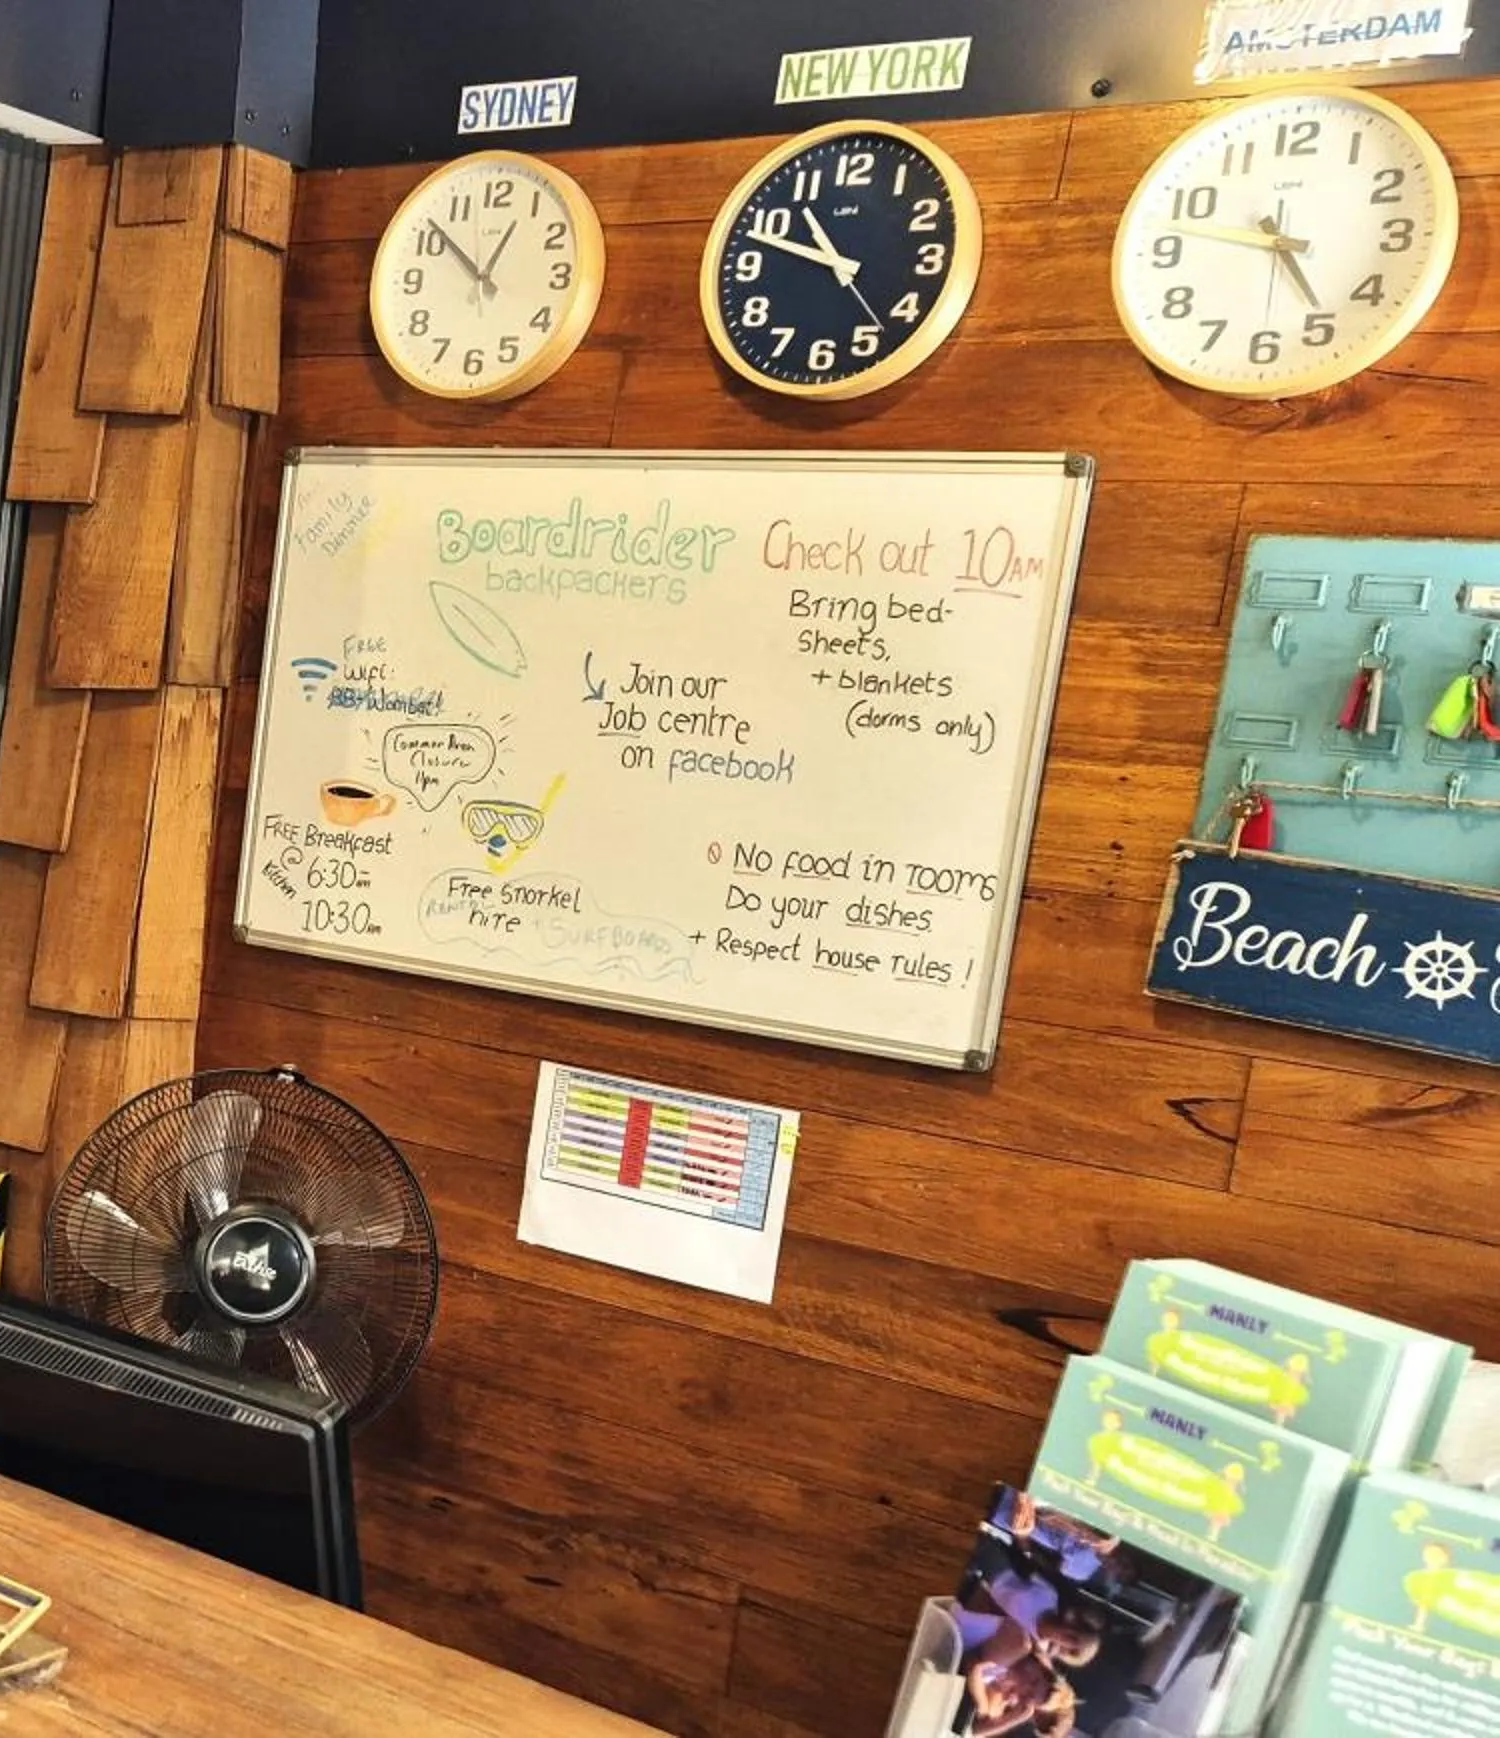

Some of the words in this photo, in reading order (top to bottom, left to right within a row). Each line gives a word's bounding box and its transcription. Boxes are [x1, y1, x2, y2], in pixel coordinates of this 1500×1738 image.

[781, 50, 857, 99] NEW
[867, 41, 967, 92] YORK
[462, 81, 575, 129] SYDNEY
[1274, 121, 1321, 157] 12
[1348, 131, 1362, 165] 1
[835, 153, 874, 186] 12
[1221, 142, 1255, 176] 11
[483, 180, 514, 209] 12
[793, 170, 822, 201] 11
[893, 163, 907, 195] 1
[1370, 169, 1405, 205] 2
[449, 195, 471, 222] 11
[531, 191, 540, 218] 1
[908, 198, 940, 232] 2
[1171, 186, 1218, 221] 10
[544, 222, 567, 250] 2
[753, 207, 791, 239] 10
[1379, 218, 1415, 253] 3
[416, 229, 446, 257] 10
[915, 243, 946, 275] 3
[1152, 235, 1183, 269] 9
[403, 268, 424, 295] 9
[549, 262, 572, 291] 3
[735, 251, 763, 282] 9
[1161, 286, 1194, 320] 8
[1349, 273, 1385, 307] 4
[408, 310, 430, 336] 8
[529, 306, 552, 333] 4
[741, 296, 769, 328] 8
[889, 292, 920, 323] 4
[769, 327, 795, 358] 7
[851, 325, 880, 357] 5
[1199, 320, 1228, 353] 7
[1301, 312, 1336, 347] 5
[432, 338, 451, 364] 7
[463, 349, 484, 376] 6
[497, 336, 520, 364] 5
[807, 339, 837, 371] 6
[1248, 331, 1282, 365] 6
[437, 497, 736, 572] Boardrider
[763, 519, 866, 576] Check
[880, 528, 936, 576] out
[486, 561, 687, 604] backpackers
[789, 589, 877, 635] Bring
[620, 662, 673, 699] Join
[682, 676, 728, 700] our
[839, 669, 953, 698] blankets
[599, 701, 647, 731] Job
[658, 705, 750, 745] centre
[845, 700, 921, 739] (dorms
[936, 711, 997, 755] only)
[621, 745, 654, 769] on
[669, 748, 795, 784] facebook
[304, 823, 393, 859] Breakfast
[280, 845, 304, 872] @
[733, 842, 773, 873] No
[782, 849, 853, 880] food
[862, 854, 896, 883] in
[905, 863, 999, 902] rooms
[448, 876, 493, 899] Free
[469, 908, 521, 932] hire
[725, 885, 761, 913] Do
[771, 895, 828, 929] your
[716, 927, 802, 962] Respect
[814, 937, 881, 973] house
[1172, 880, 1386, 988] Beach
[1147, 1407, 1210, 1441] MANLY
